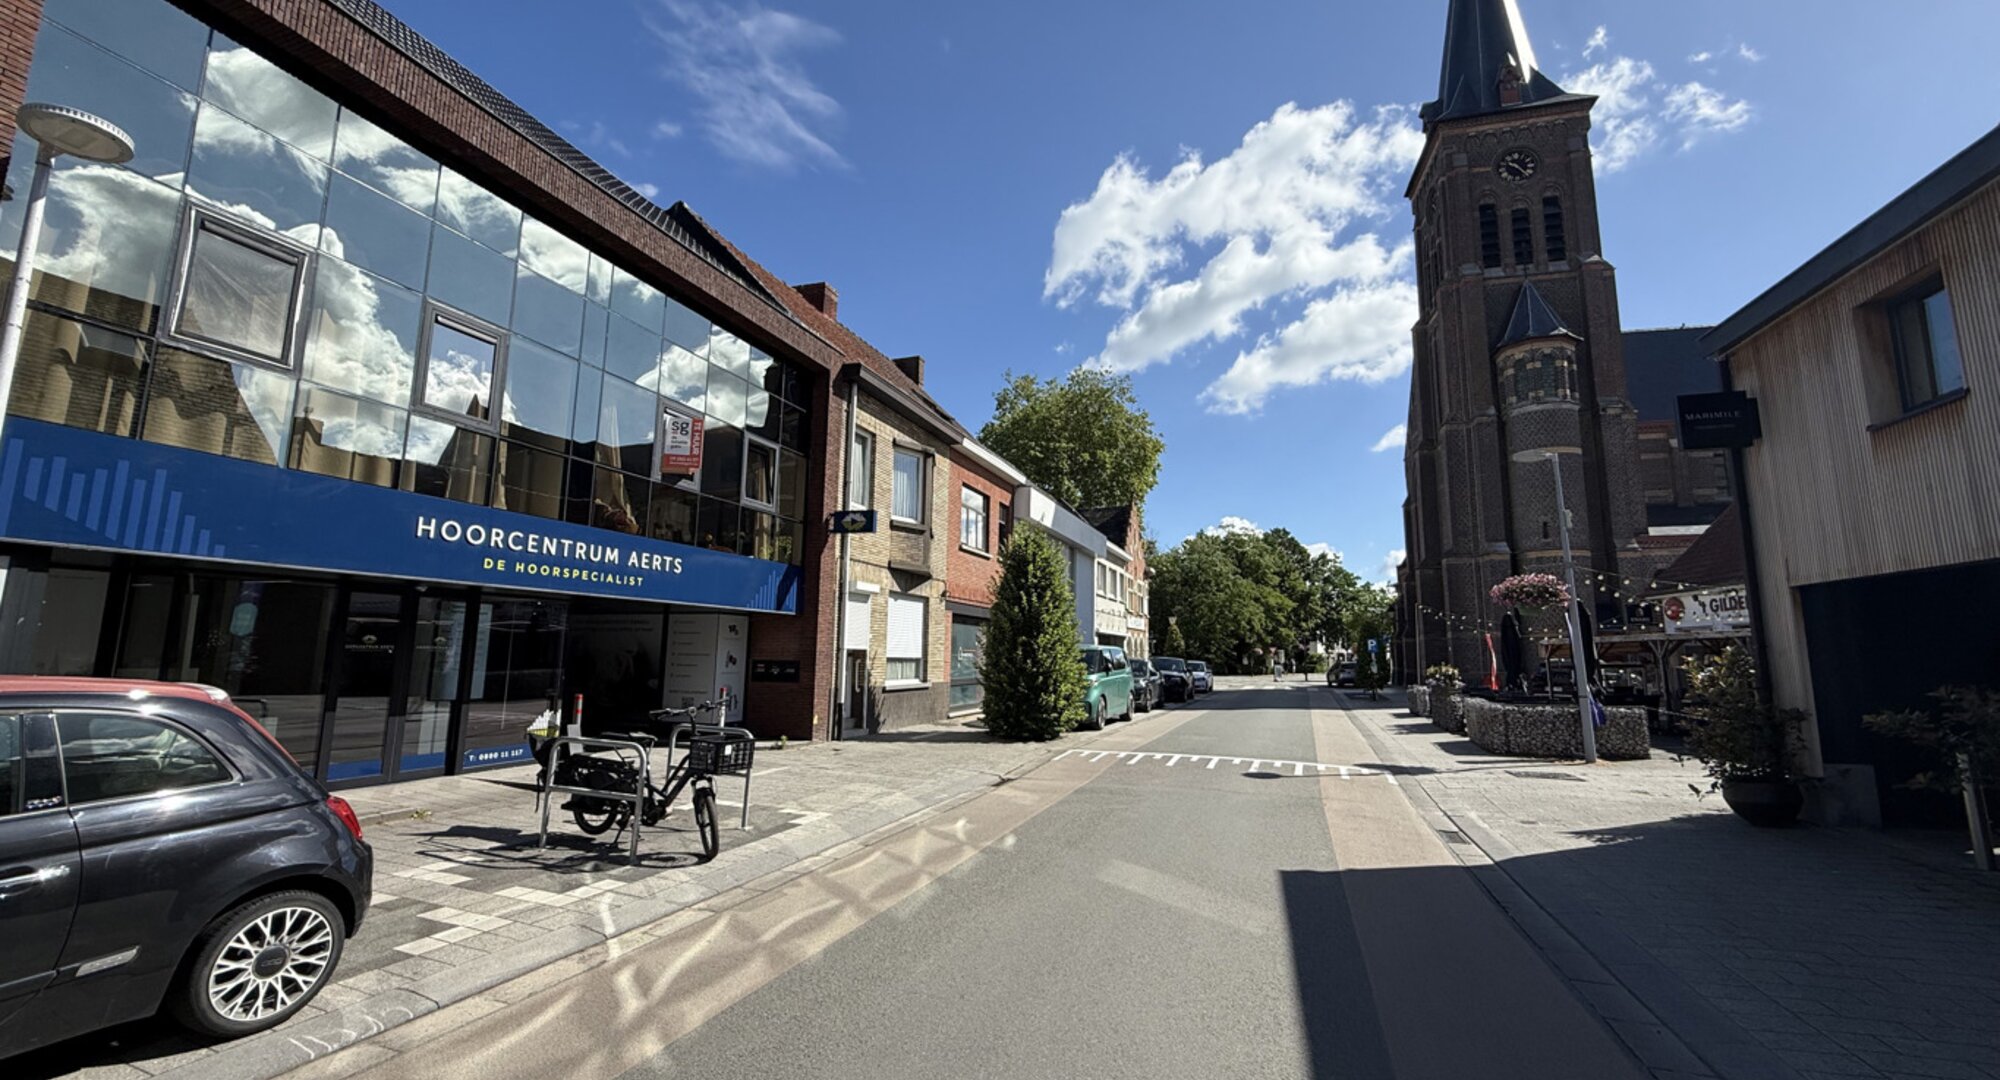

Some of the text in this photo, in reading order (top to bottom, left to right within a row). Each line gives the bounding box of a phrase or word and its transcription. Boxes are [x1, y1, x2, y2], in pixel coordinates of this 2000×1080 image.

[671, 420, 690, 436] sg
[416, 515, 683, 574] HOORCENTRUM AERTS
[483, 557, 644, 587] DE HOORSPECIALIST
